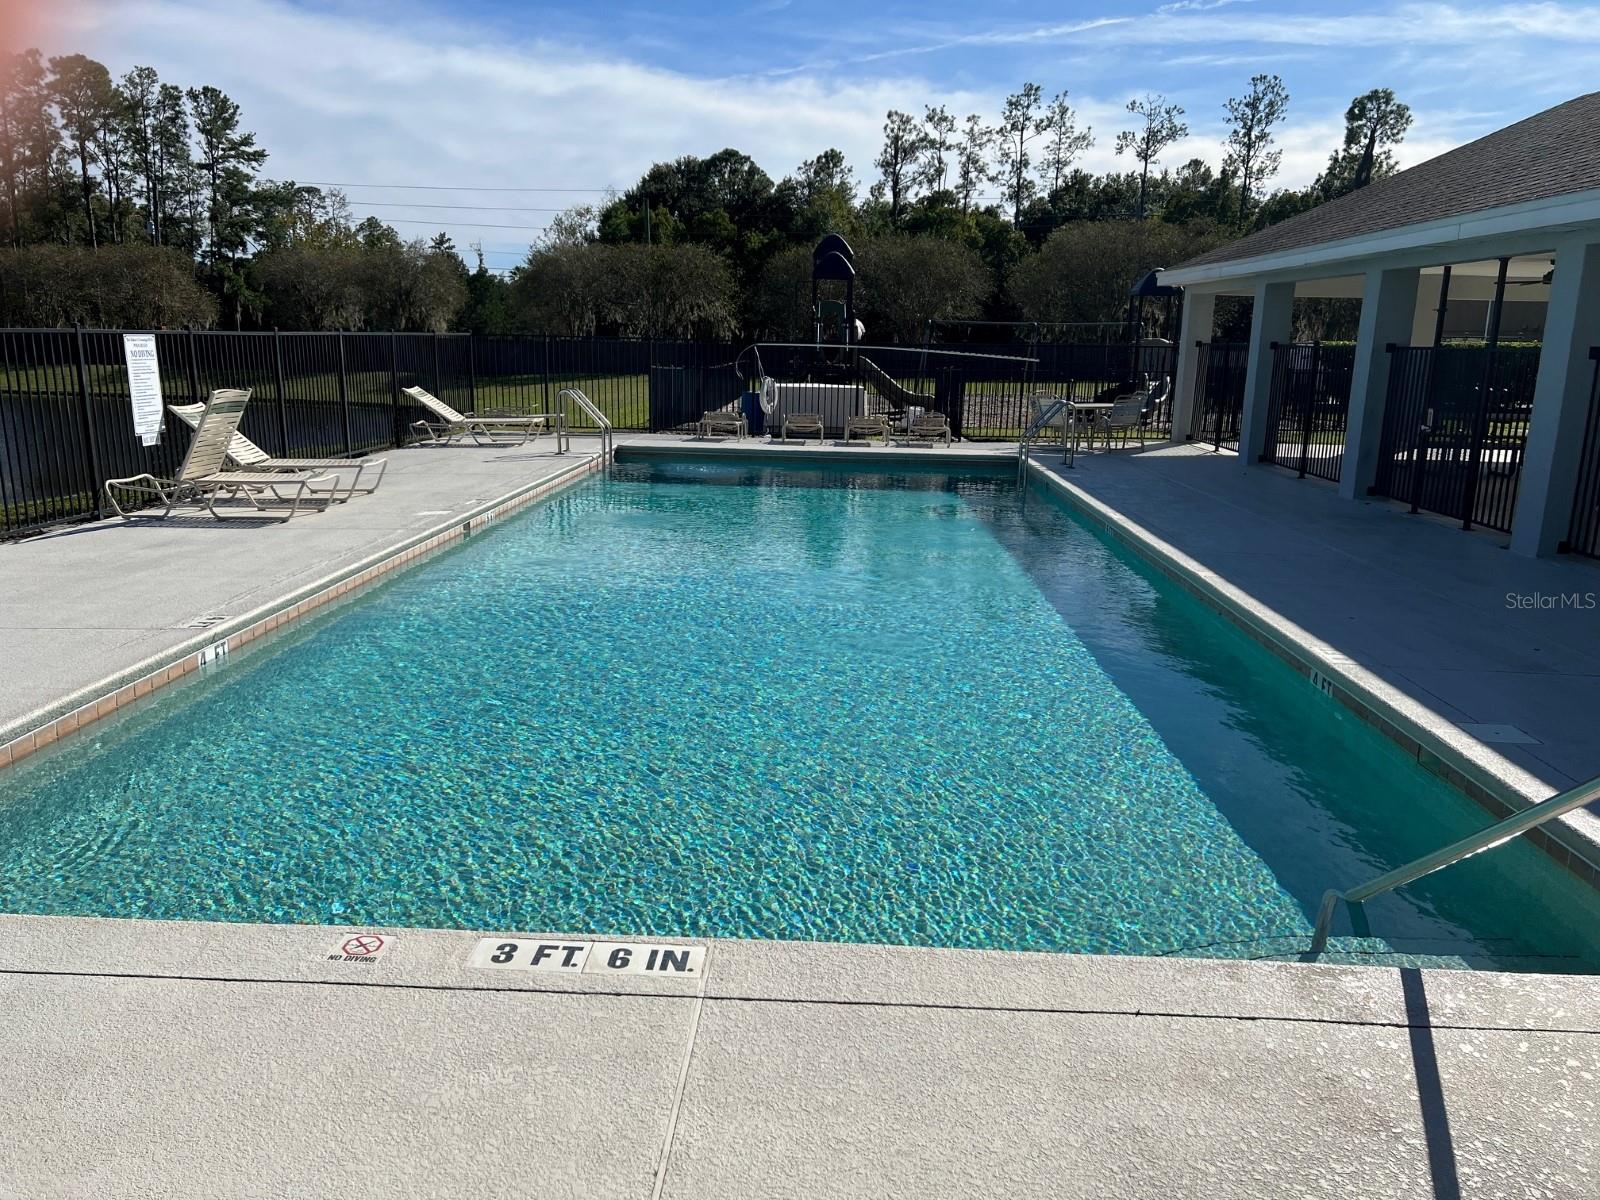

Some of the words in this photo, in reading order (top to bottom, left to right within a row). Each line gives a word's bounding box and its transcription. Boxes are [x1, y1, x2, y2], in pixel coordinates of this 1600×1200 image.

[130, 350, 138, 358] NO
[214, 641, 226, 659] FT
[1312, 671, 1318, 686] 4
[1321, 677, 1332, 695] FT
[343, 955, 377, 963] DIVING
[490, 943, 519, 964] 3
[530, 944, 584, 968] FT.
[607, 948, 633, 970] 6
[645, 949, 694, 973] IN.
